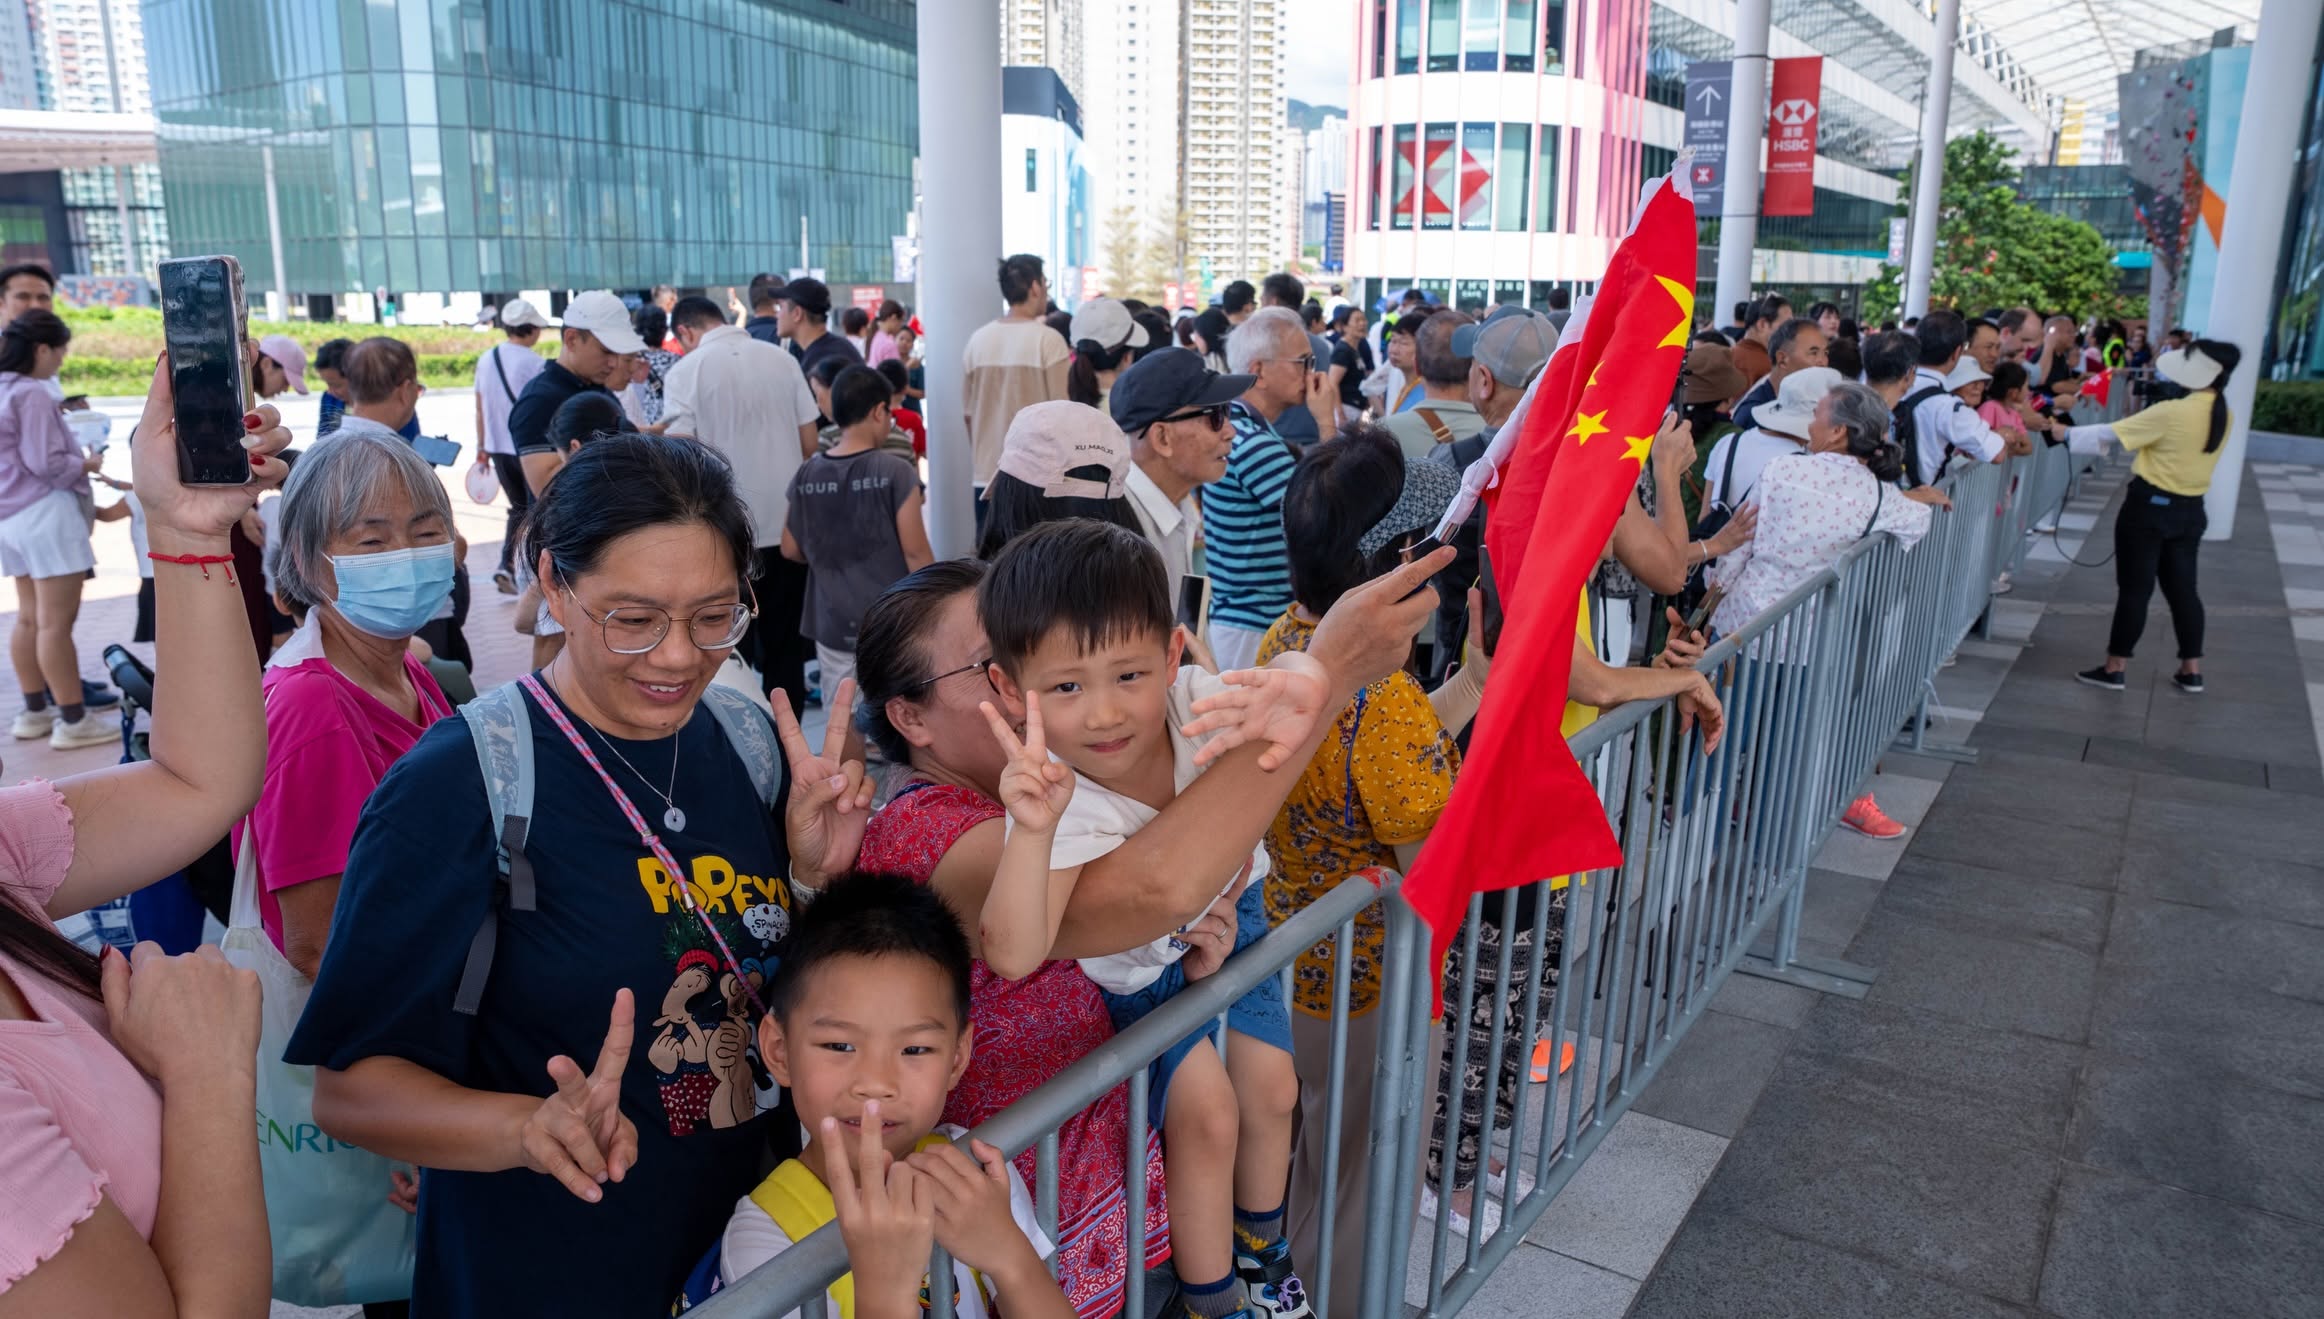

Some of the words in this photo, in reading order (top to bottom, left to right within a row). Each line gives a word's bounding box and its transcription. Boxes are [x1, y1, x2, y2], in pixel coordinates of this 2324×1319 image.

[1773, 139, 1809, 152] HSBC
[797, 481, 838, 495] YOUR
[852, 477, 889, 491] SELF
